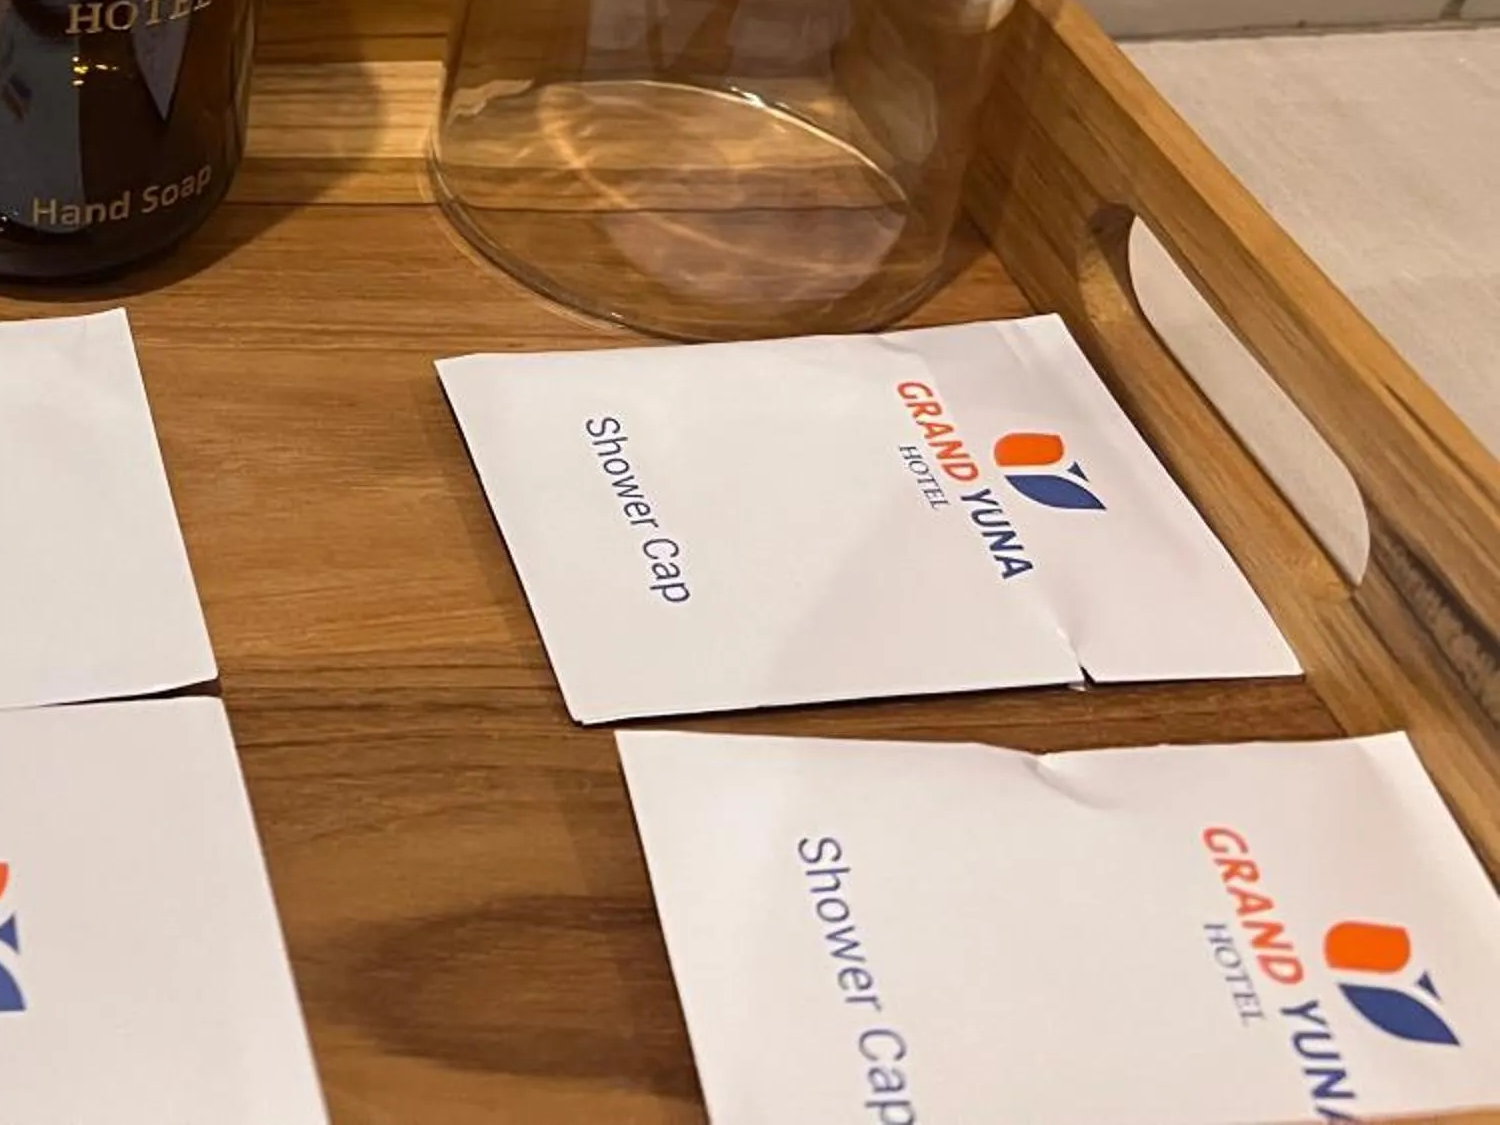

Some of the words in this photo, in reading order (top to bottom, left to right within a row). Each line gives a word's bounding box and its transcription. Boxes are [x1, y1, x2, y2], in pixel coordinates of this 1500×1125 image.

[32, 190, 131, 226] Hand
[141, 164, 213, 214] Soap
[586, 415, 660, 530] Shower
[642, 538, 691, 605] Cap
[897, 380, 979, 483] GRAND
[961, 488, 1034, 580] YUNA
[898, 445, 951, 511] HOTEL
[798, 837, 882, 1012] Shower
[858, 1028, 915, 1125] Cap
[1203, 827, 1305, 985] GRAND
[1203, 921, 1266, 1026] HOTEL
